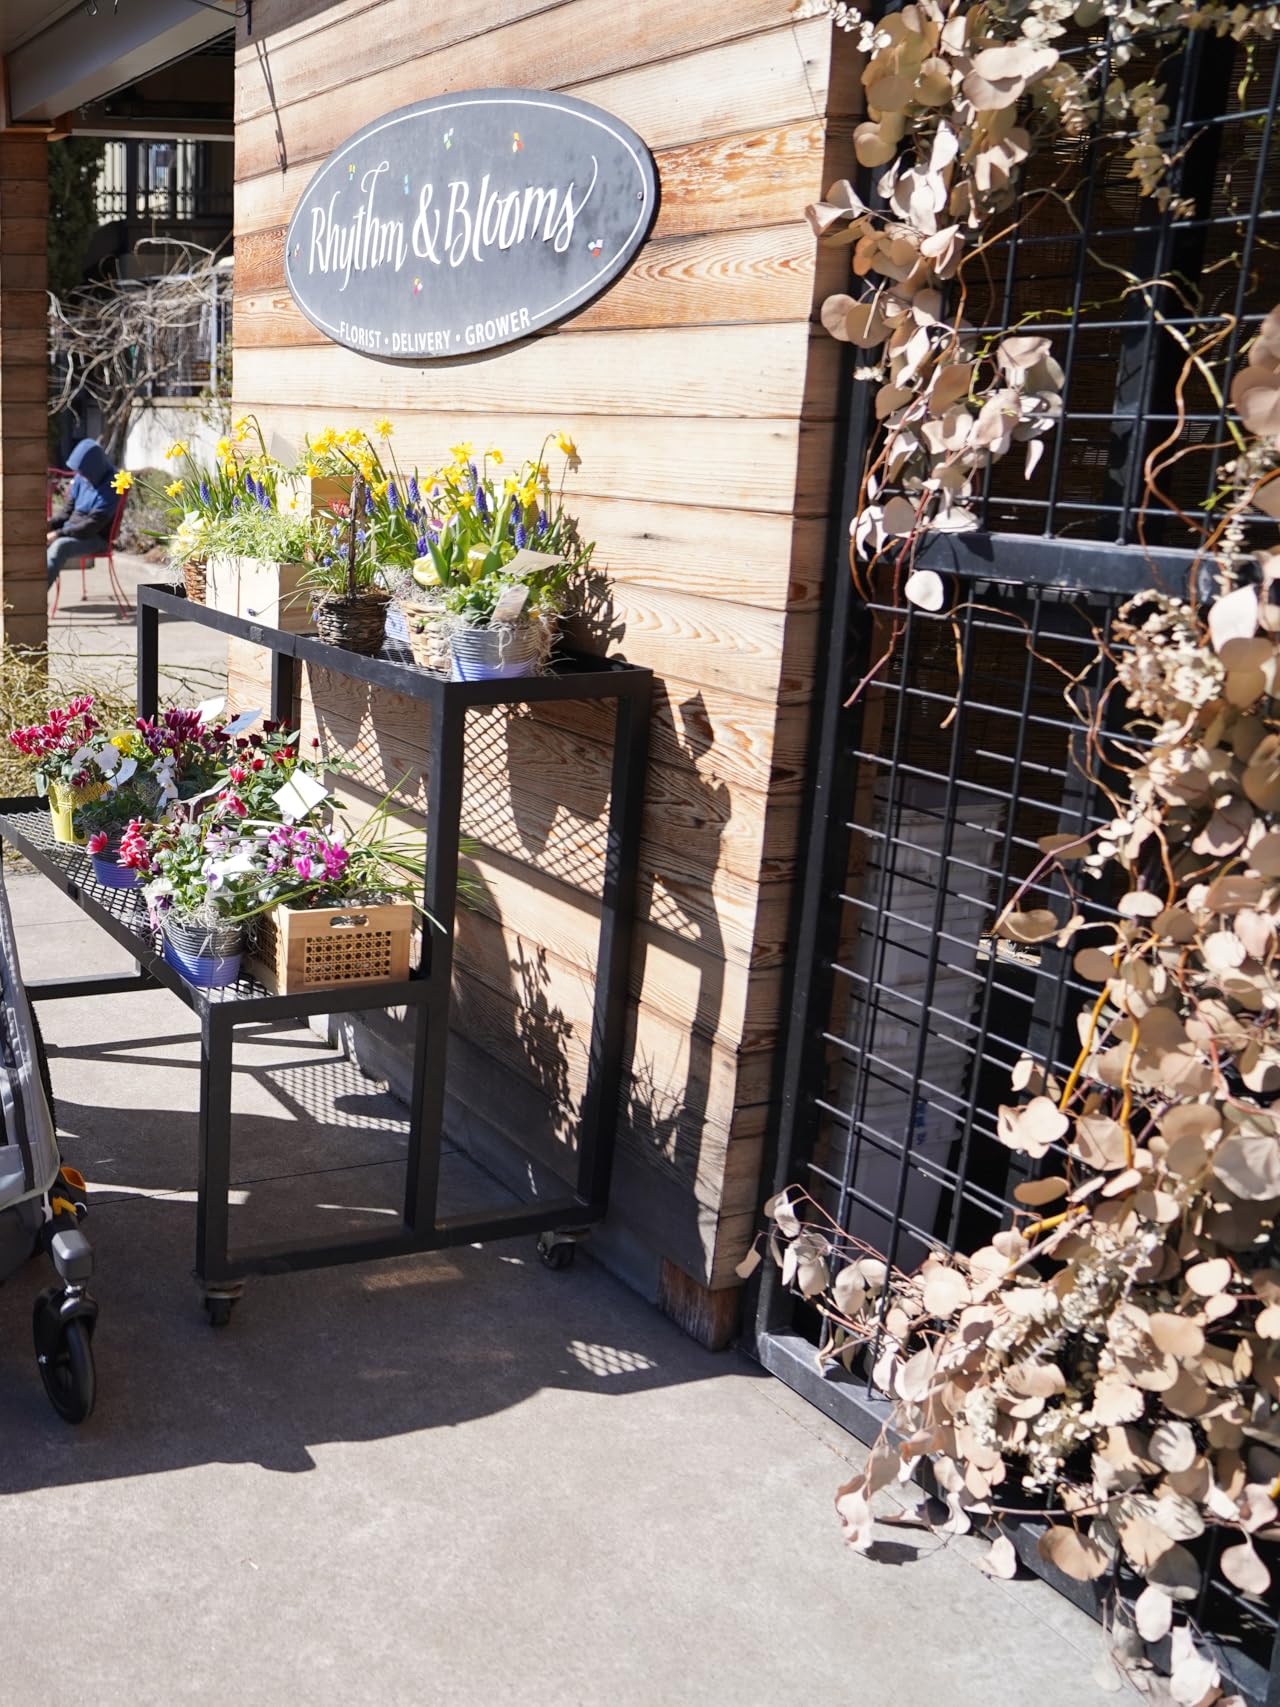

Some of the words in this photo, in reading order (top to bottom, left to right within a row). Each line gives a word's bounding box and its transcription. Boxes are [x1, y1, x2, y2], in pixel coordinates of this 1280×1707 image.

[309, 161, 408, 291] Rhythm
[412, 183, 441, 264] &
[445, 156, 598, 267] Blooms
[340, 321, 381, 349] FLORIST
[392, 330, 451, 352] DELIVERY
[465, 307, 531, 346] GROWER
